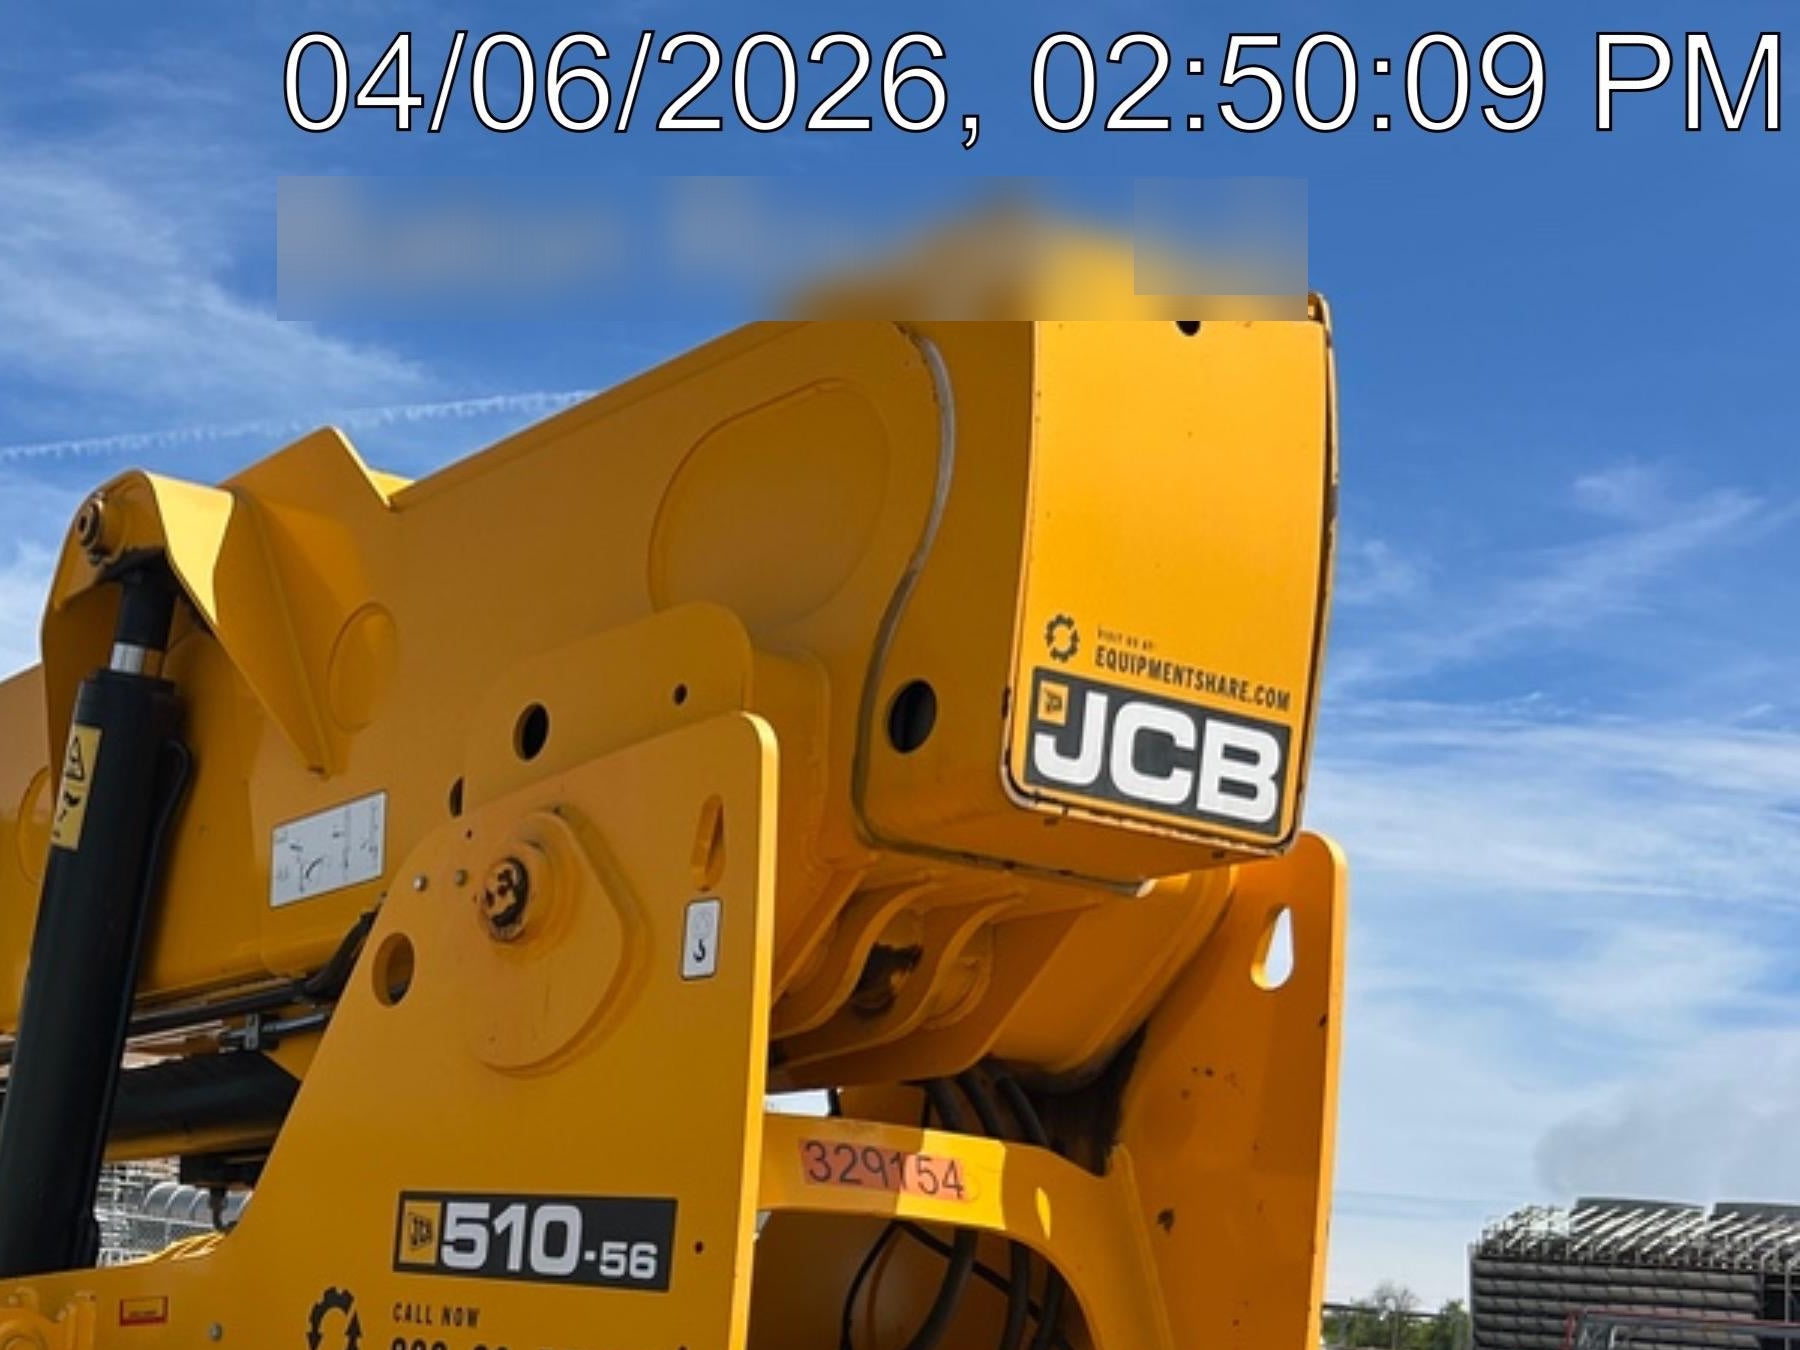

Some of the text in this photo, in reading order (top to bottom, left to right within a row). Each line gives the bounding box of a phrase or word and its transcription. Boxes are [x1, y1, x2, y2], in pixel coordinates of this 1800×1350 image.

[1095, 645, 1291, 711] EQUIPMENTSHARE.COM
[1034, 691, 1280, 823] JCB
[805, 1139, 964, 1199] 329154
[393, 1302, 481, 1328] CALL NOW
